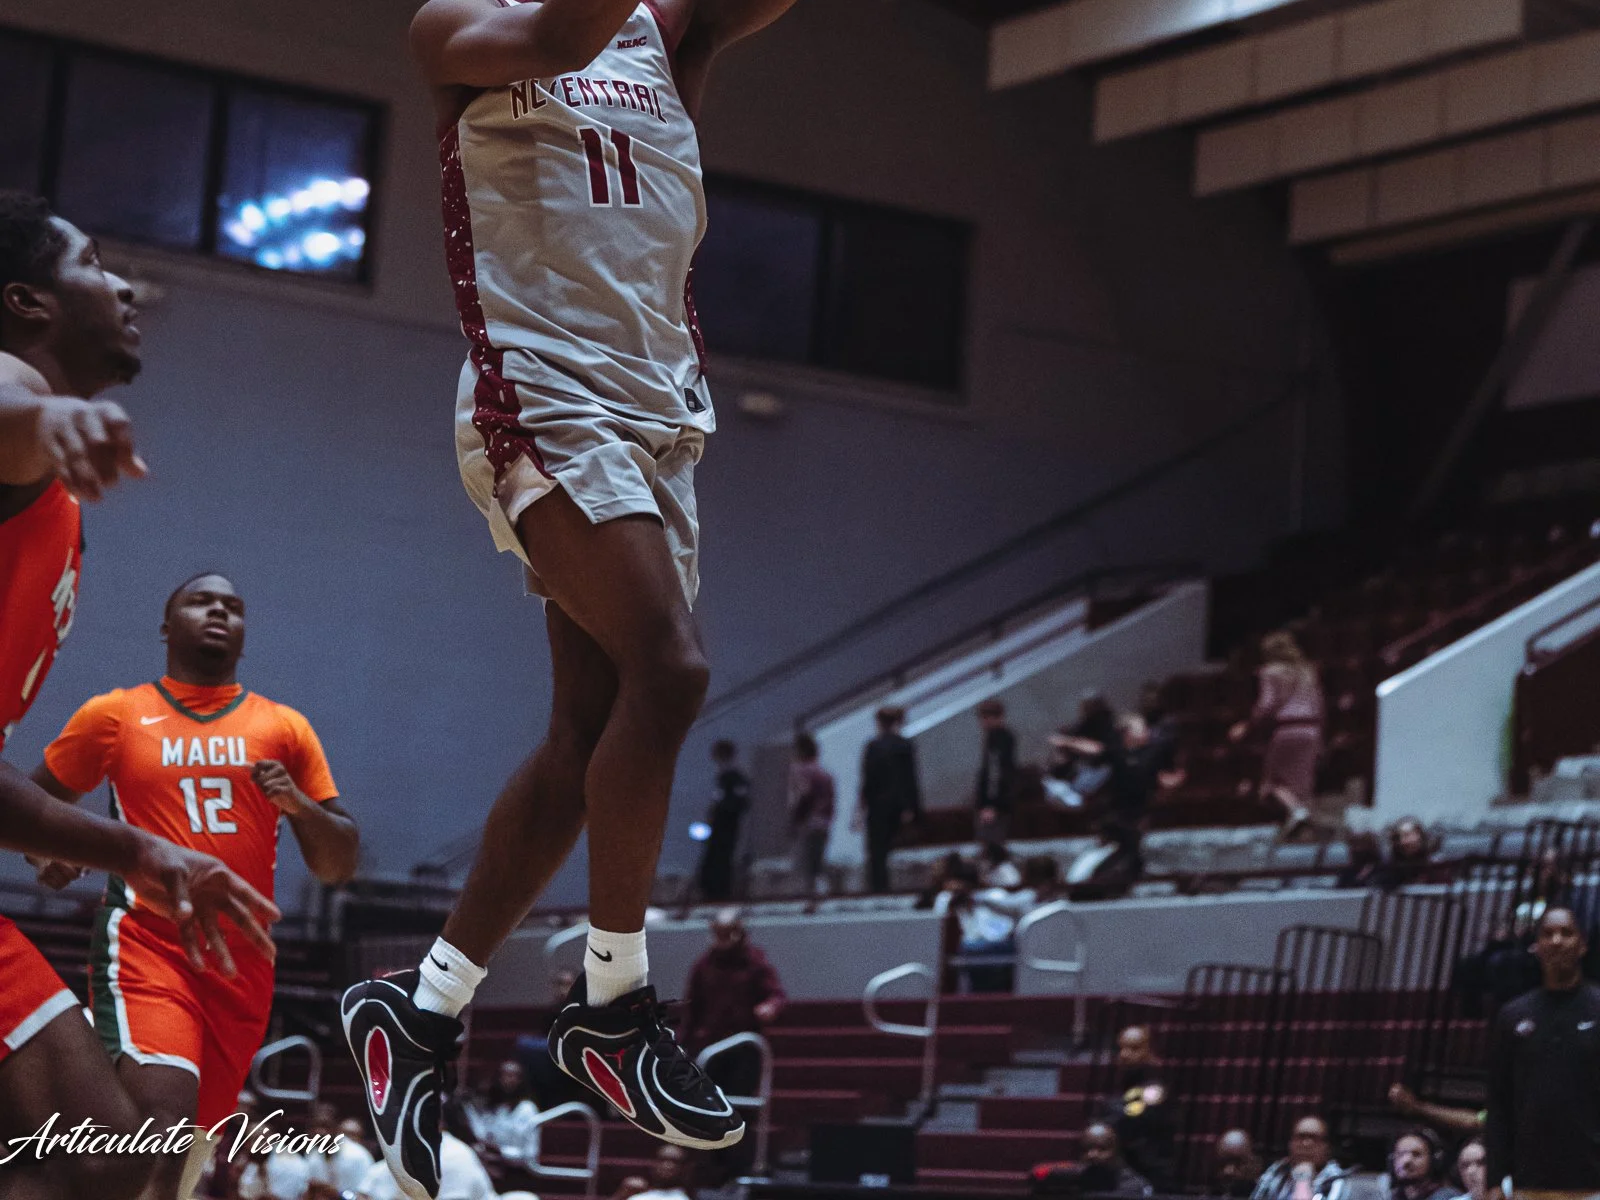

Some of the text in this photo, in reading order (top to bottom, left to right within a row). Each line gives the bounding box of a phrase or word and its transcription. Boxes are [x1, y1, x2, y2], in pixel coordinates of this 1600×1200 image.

[616, 36, 647, 50] MEAC
[575, 125, 644, 208] 11
[161, 736, 247, 767] MACU
[178, 776, 238, 834] 12
